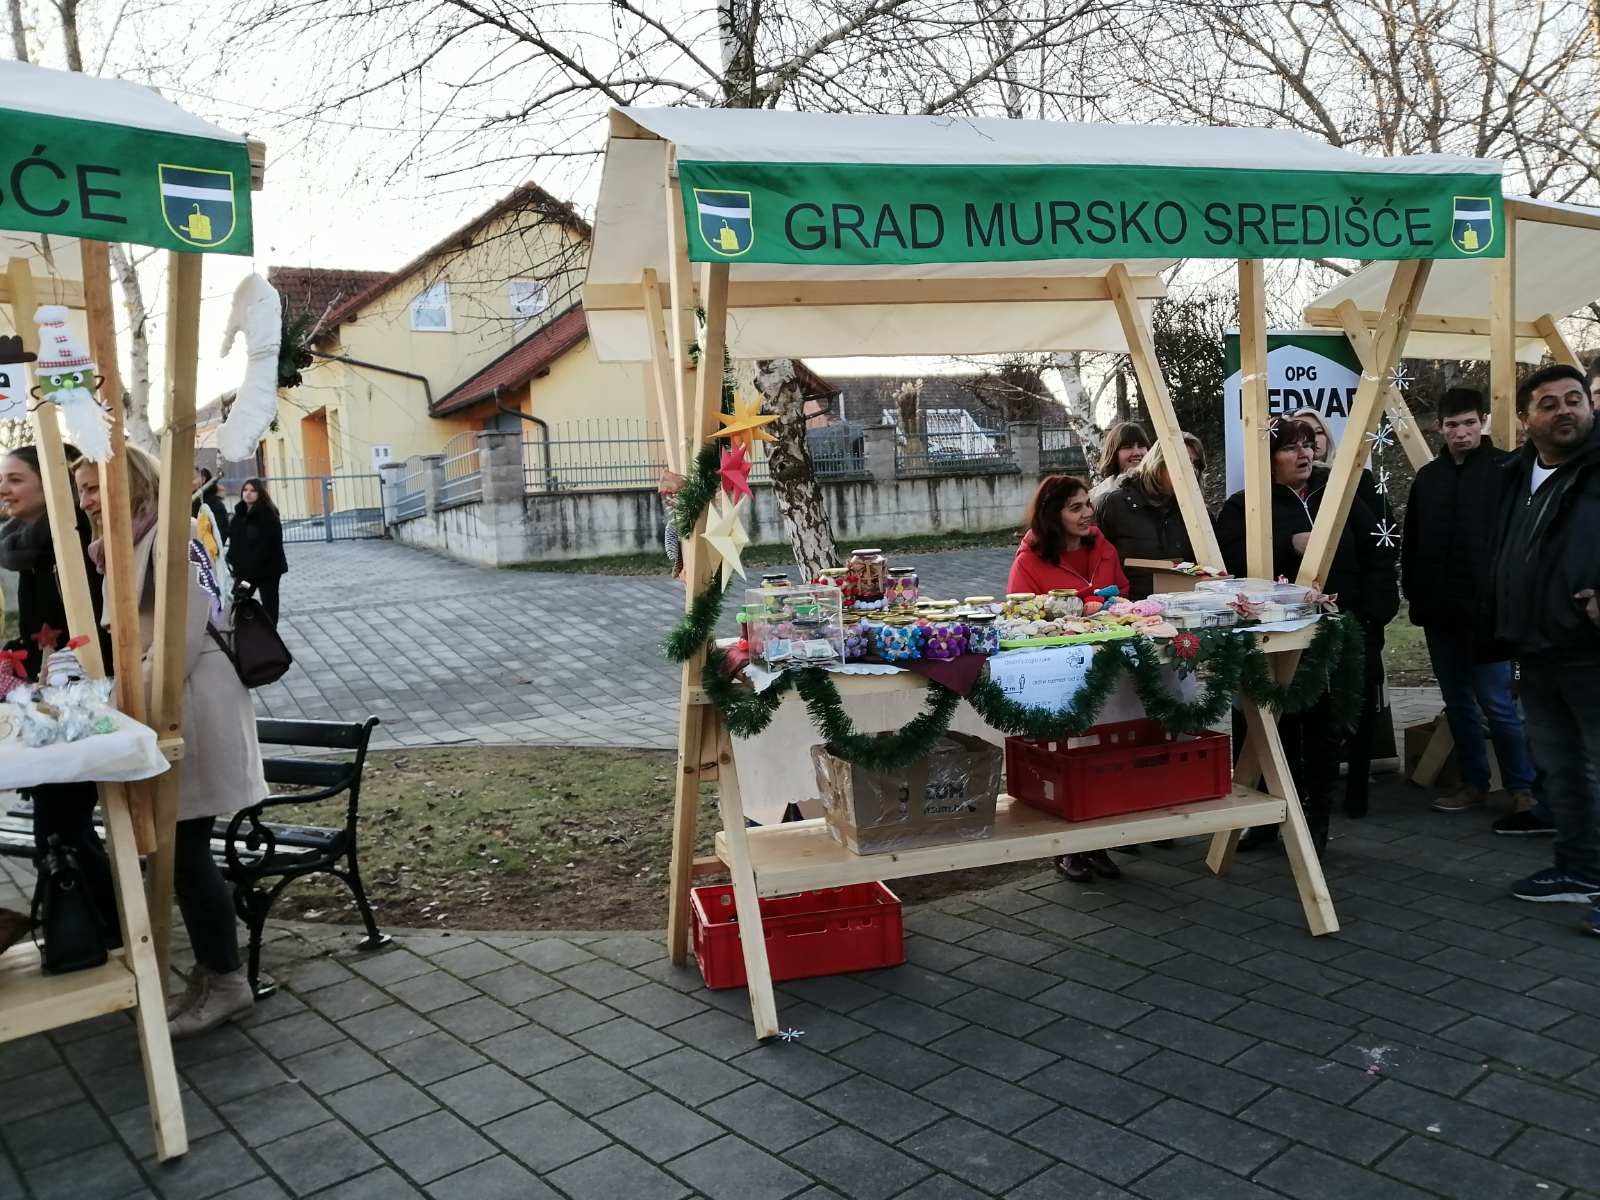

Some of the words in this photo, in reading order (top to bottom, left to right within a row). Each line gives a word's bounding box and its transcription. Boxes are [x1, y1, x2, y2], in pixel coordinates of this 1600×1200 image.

[0, 144, 127, 224] ĆE
[784, 203, 944, 251] GRAD
[964, 200, 1187, 248] MURSKO
[1204, 197, 1434, 248] SREDIŠĆE
[1285, 366, 1317, 381] OPG
[1239, 387, 1358, 420] EDVA
